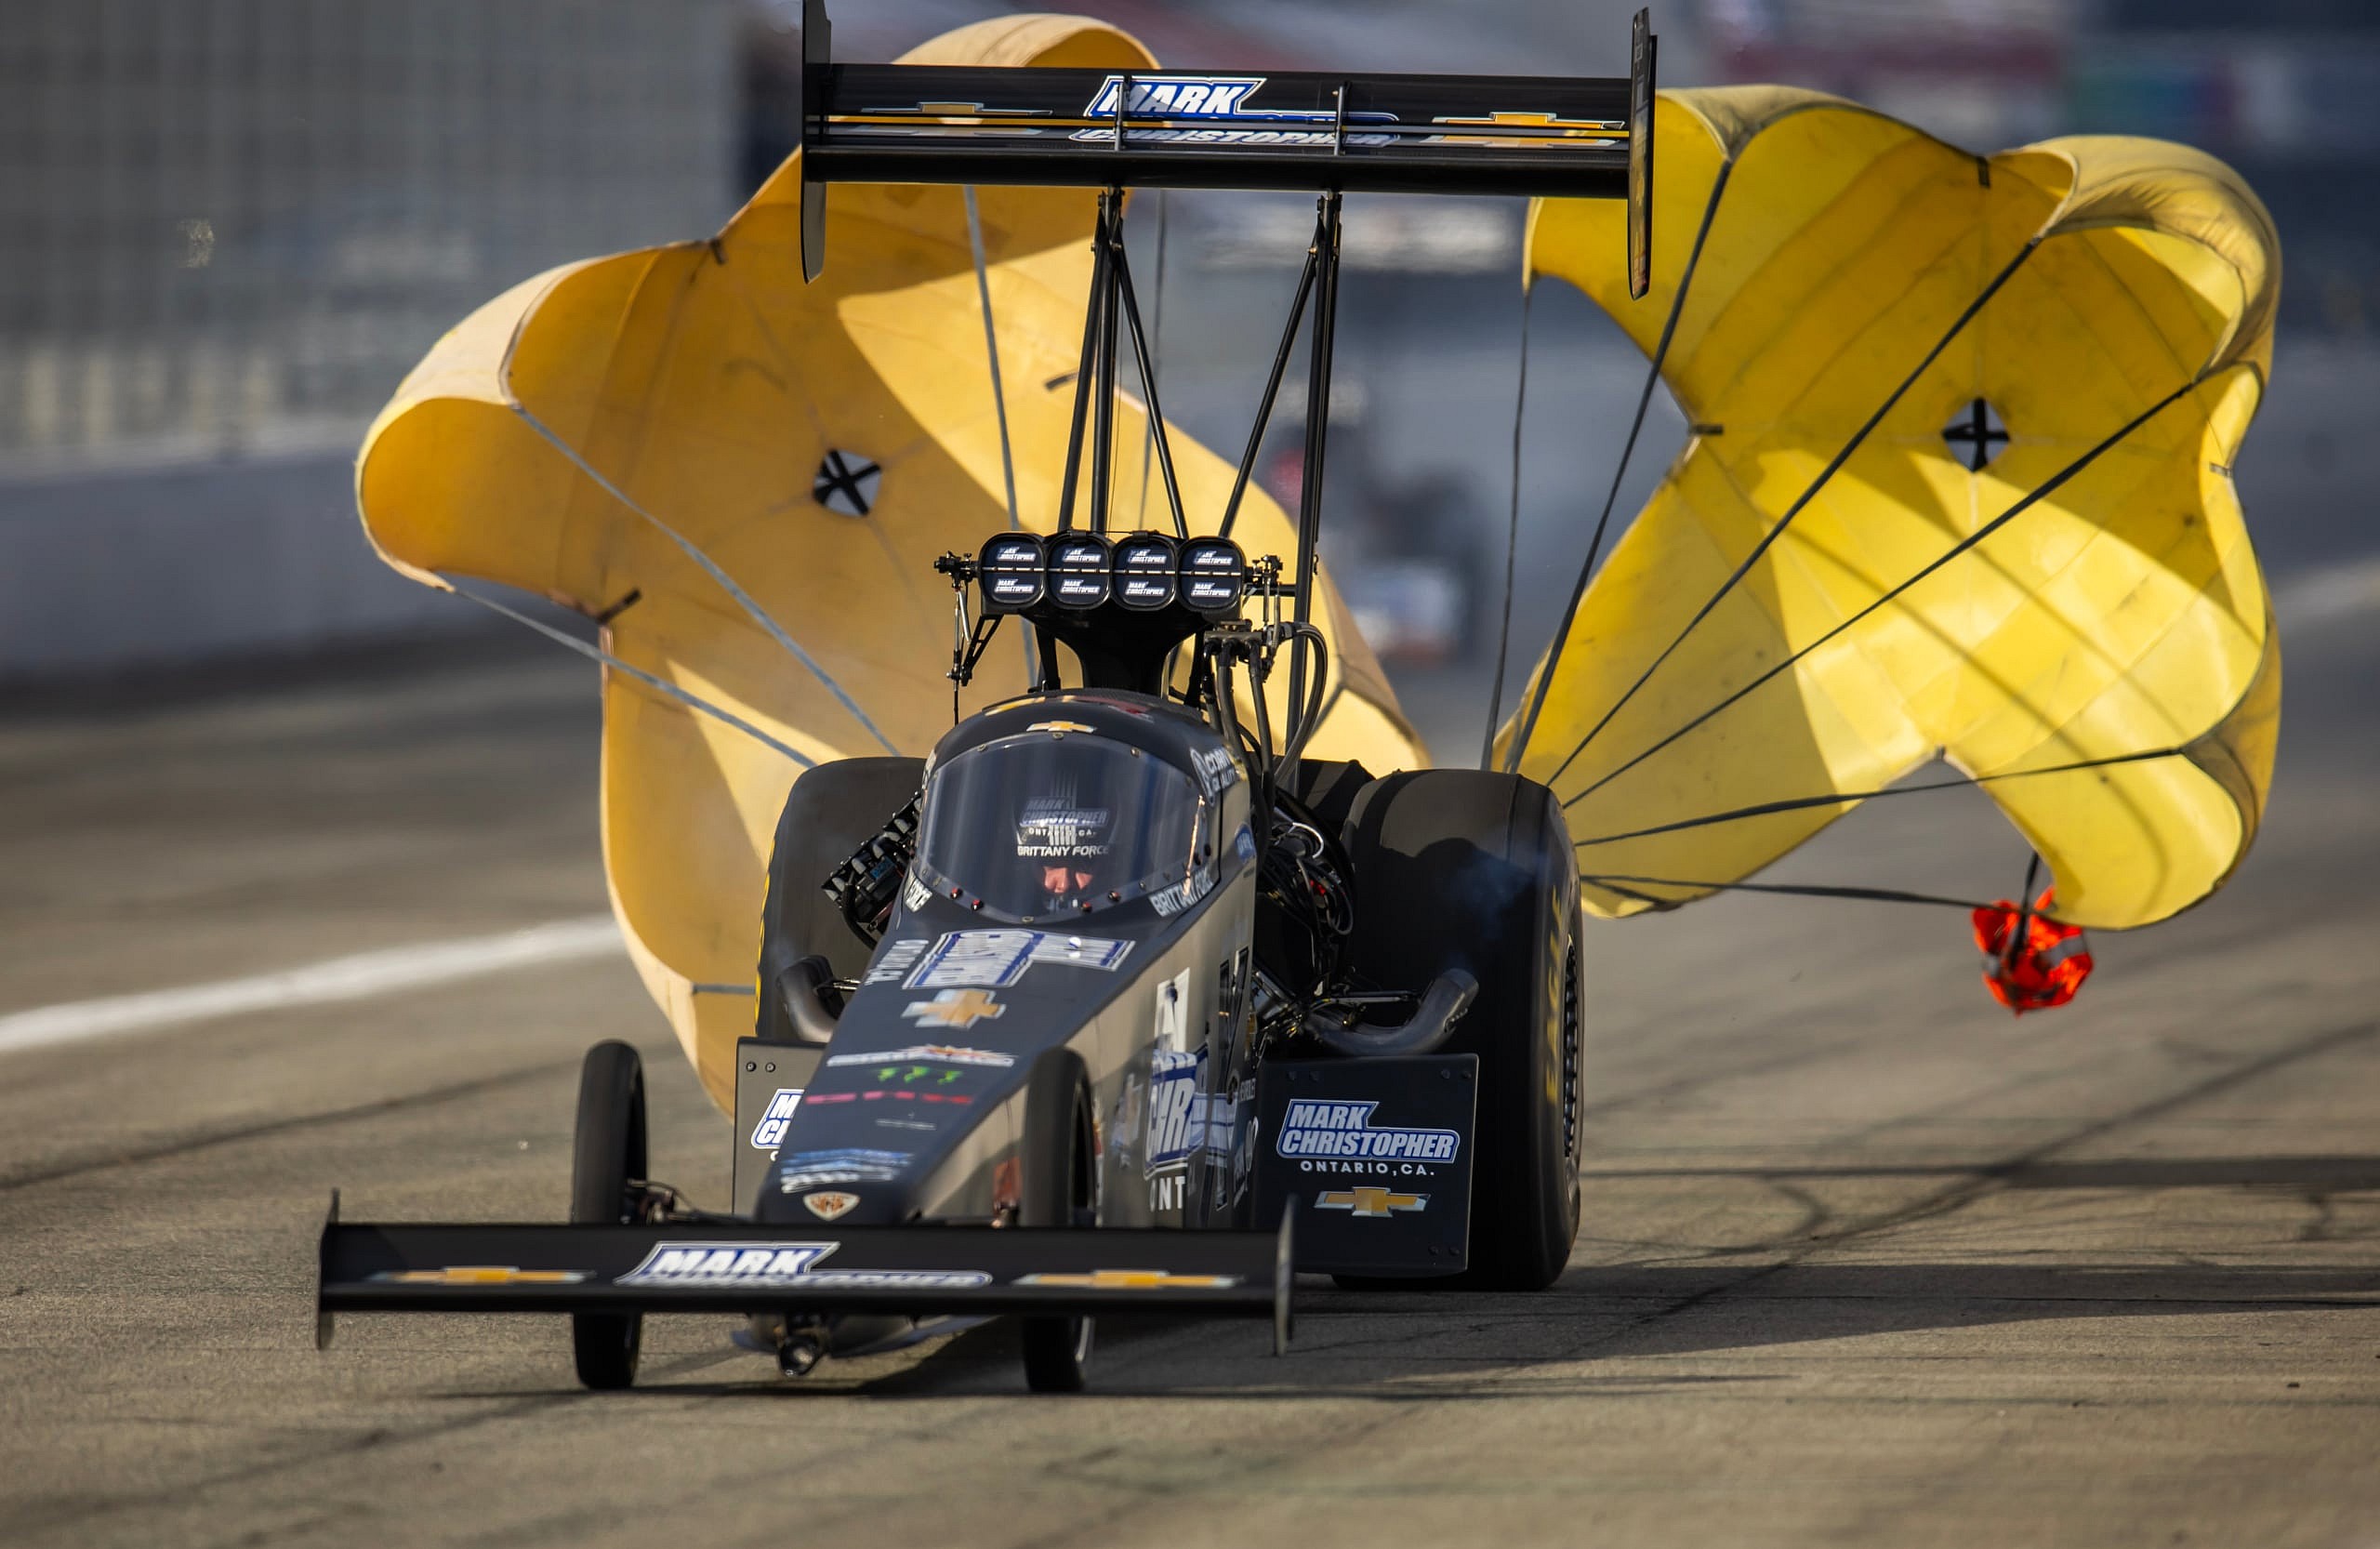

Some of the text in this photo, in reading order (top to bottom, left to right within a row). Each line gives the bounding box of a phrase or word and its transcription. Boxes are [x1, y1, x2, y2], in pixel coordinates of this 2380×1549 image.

[1096, 84, 1247, 114] MARK
[1017, 845, 1109, 856] BRITTANY FORCE
[1288, 1104, 1368, 1130] MARK
[1281, 1130, 1455, 1158] CHRISTOPHER
[650, 1249, 814, 1275] MARK
